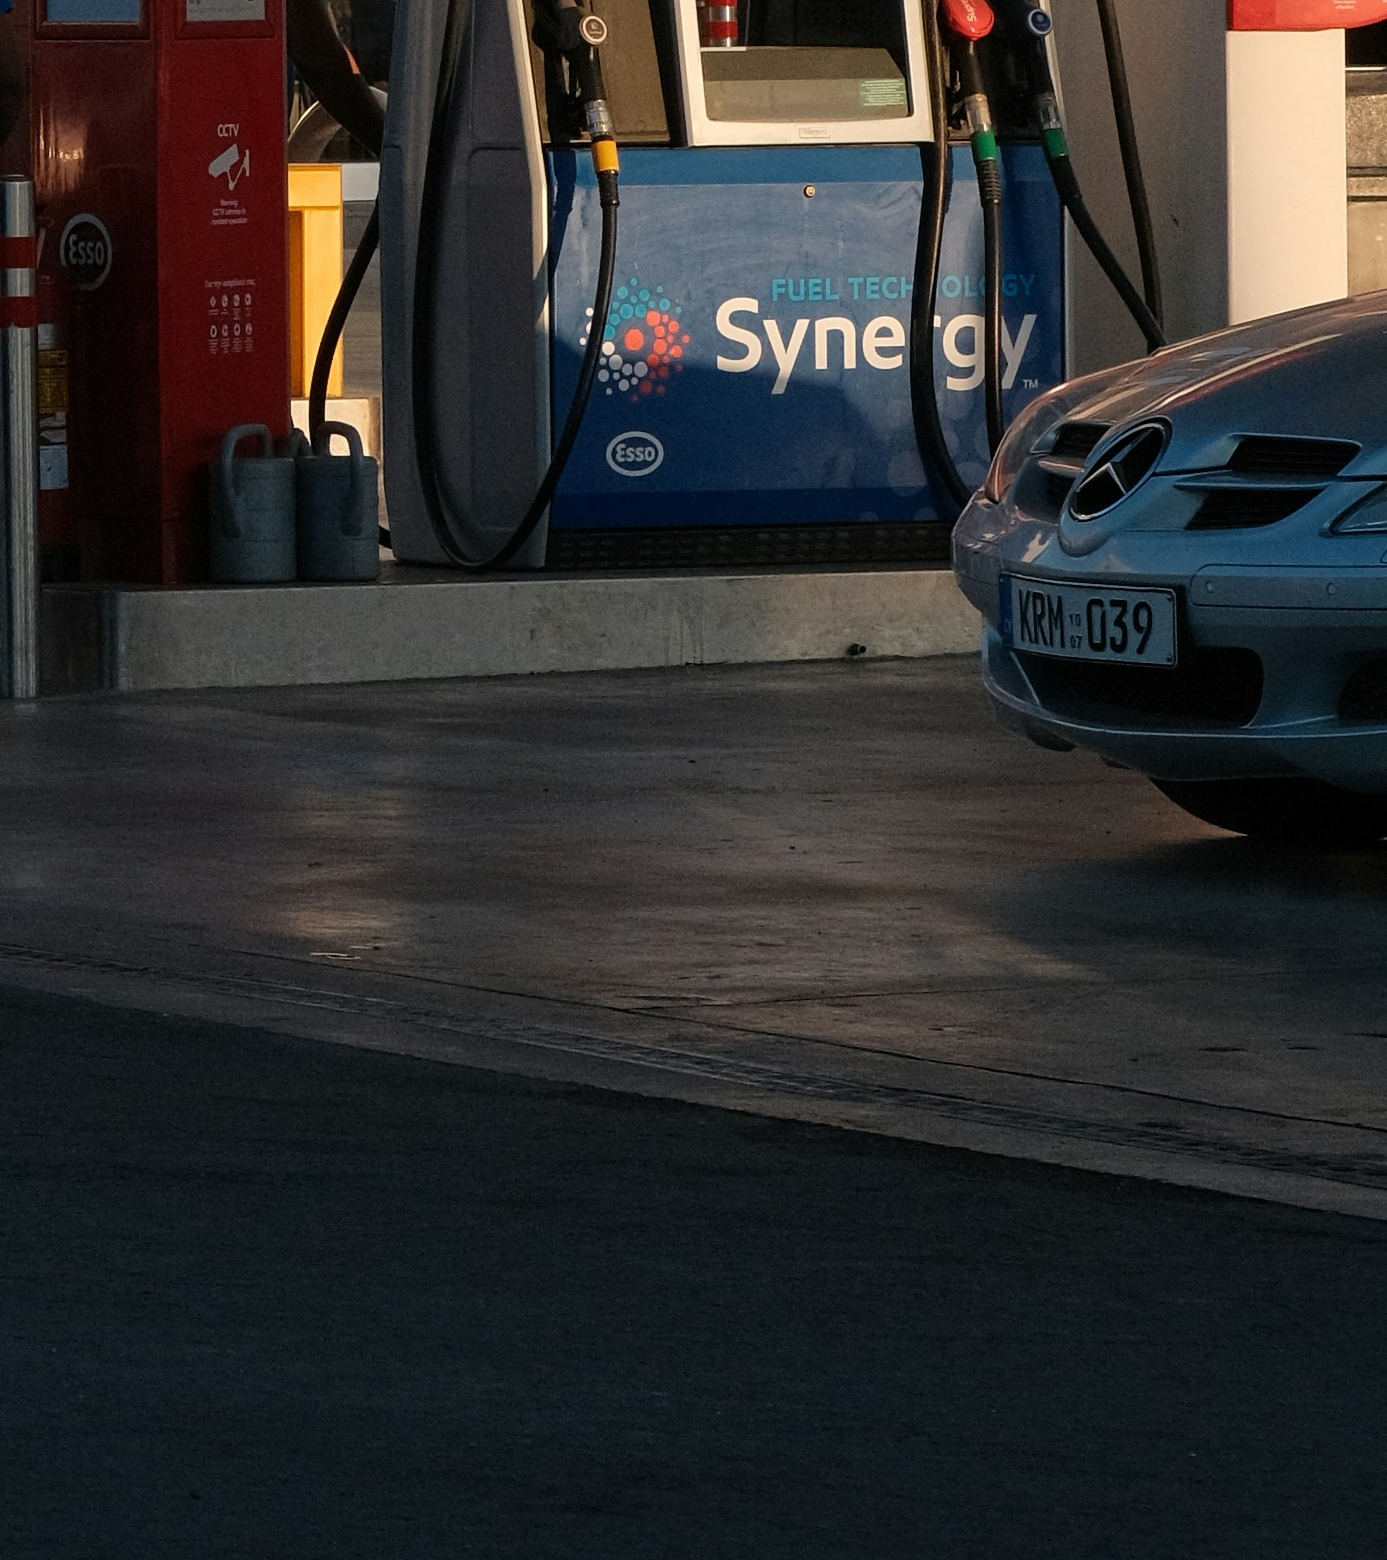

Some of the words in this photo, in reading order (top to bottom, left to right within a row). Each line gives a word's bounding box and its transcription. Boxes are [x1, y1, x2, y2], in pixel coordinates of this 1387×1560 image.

[217, 123, 239, 138] CCTV
[68, 240, 105, 266] Esso
[772, 277, 839, 301] FUEL
[848, 274, 1035, 300] TECHOLOGY
[716, 296, 1037, 395] Synegy
[615, 443, 656, 463] Esso
[1018, 588, 1066, 649] KRM
[1086, 598, 1153, 655] 039
[1069, 613, 1082, 627] 10
[1070, 634, 1084, 649] 07
